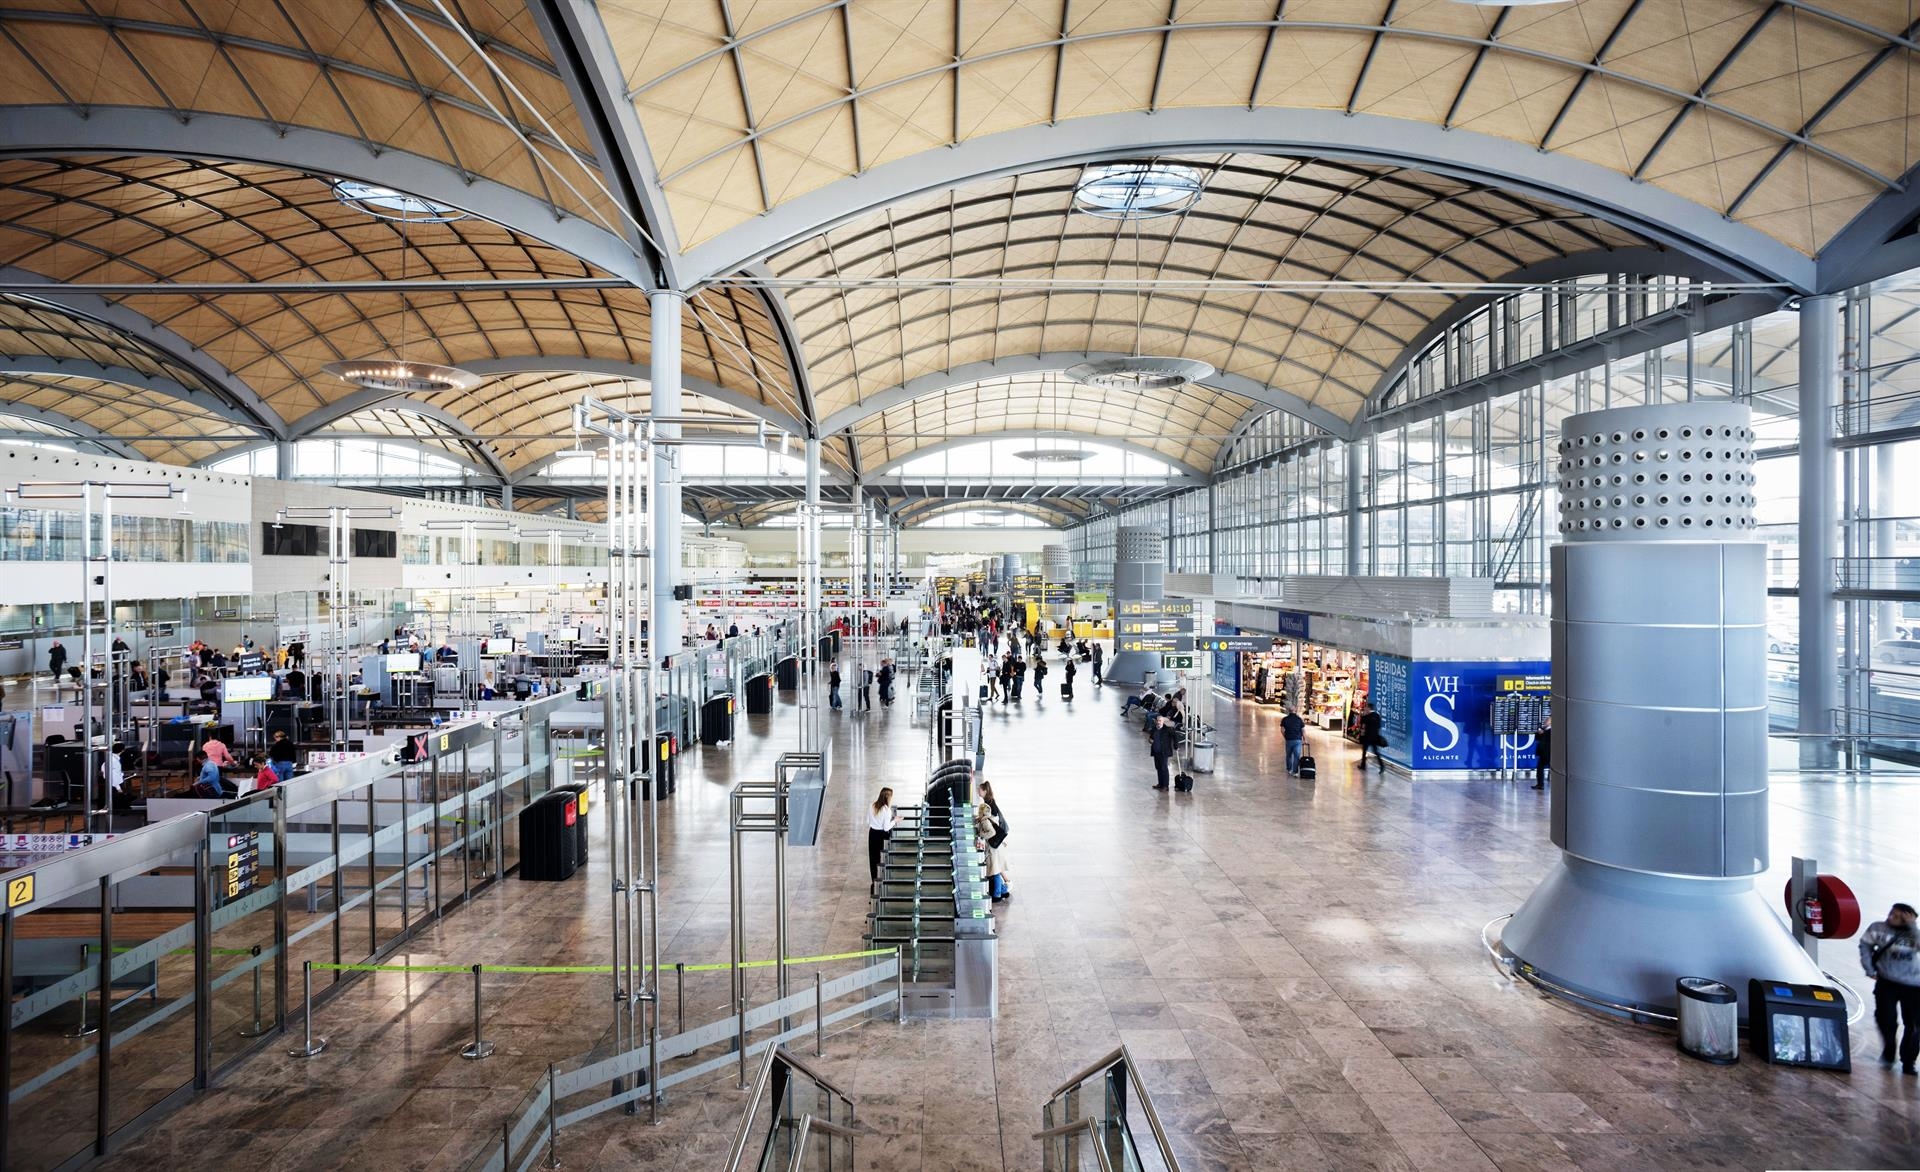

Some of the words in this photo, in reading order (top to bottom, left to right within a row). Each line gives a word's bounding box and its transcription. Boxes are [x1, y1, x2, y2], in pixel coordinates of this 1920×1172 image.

[1375, 660, 1407, 678] BEBIDAS
[1424, 676, 1459, 693] WH
[1423, 693, 1459, 751] S
[15, 880, 27, 902] 2
